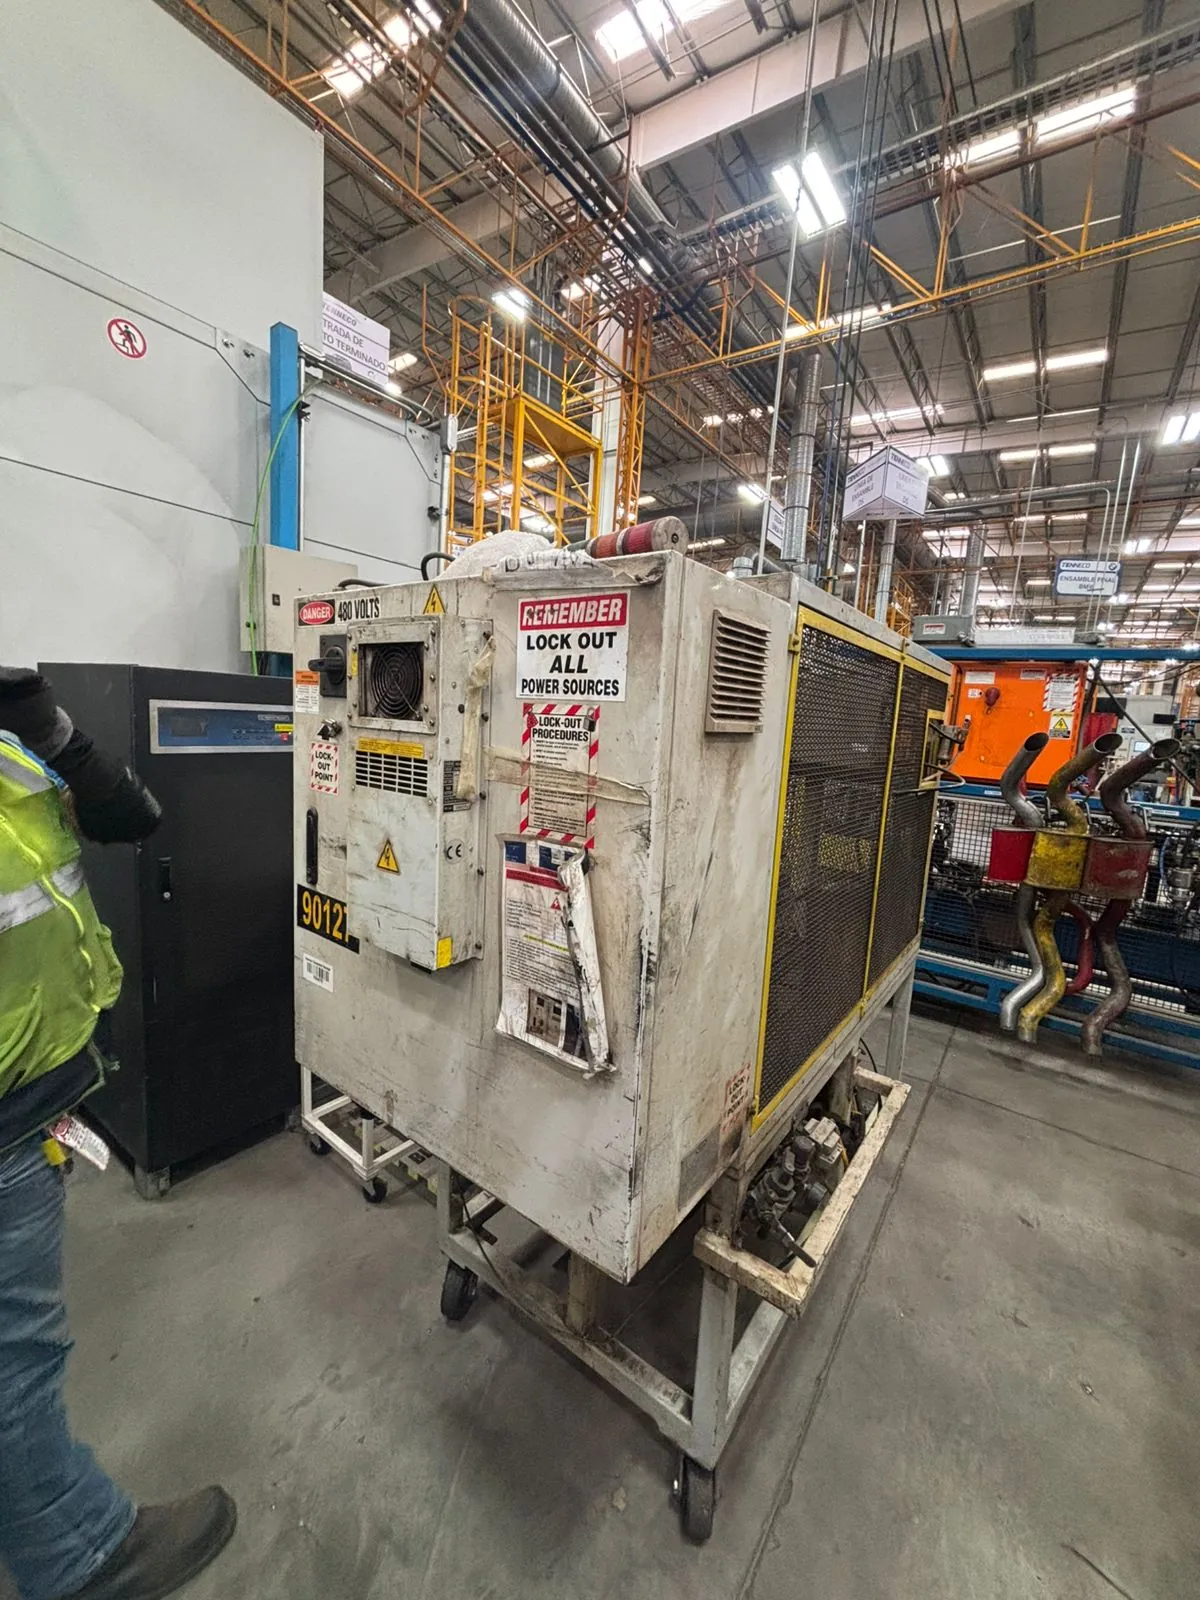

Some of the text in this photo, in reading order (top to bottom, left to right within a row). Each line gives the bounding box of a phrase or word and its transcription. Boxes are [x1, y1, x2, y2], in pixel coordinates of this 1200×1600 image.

[353, 335, 364, 348] DE
[336, 338, 386, 371] TERMINADO
[303, 598, 380, 622] DANGER 480 VOLTS
[522, 598, 622, 626] REMEMBER
[527, 632, 617, 650] LOCK OUT
[549, 655, 588, 673] ALL
[521, 678, 619, 696] POWER SOURCES
[539, 717, 582, 729] LOCK-OUT
[532, 729, 589, 741] PROCEDURES
[315, 751, 334, 761] LOCK-
[317, 761, 331, 771] OUT
[314, 771, 333, 782] POINT
